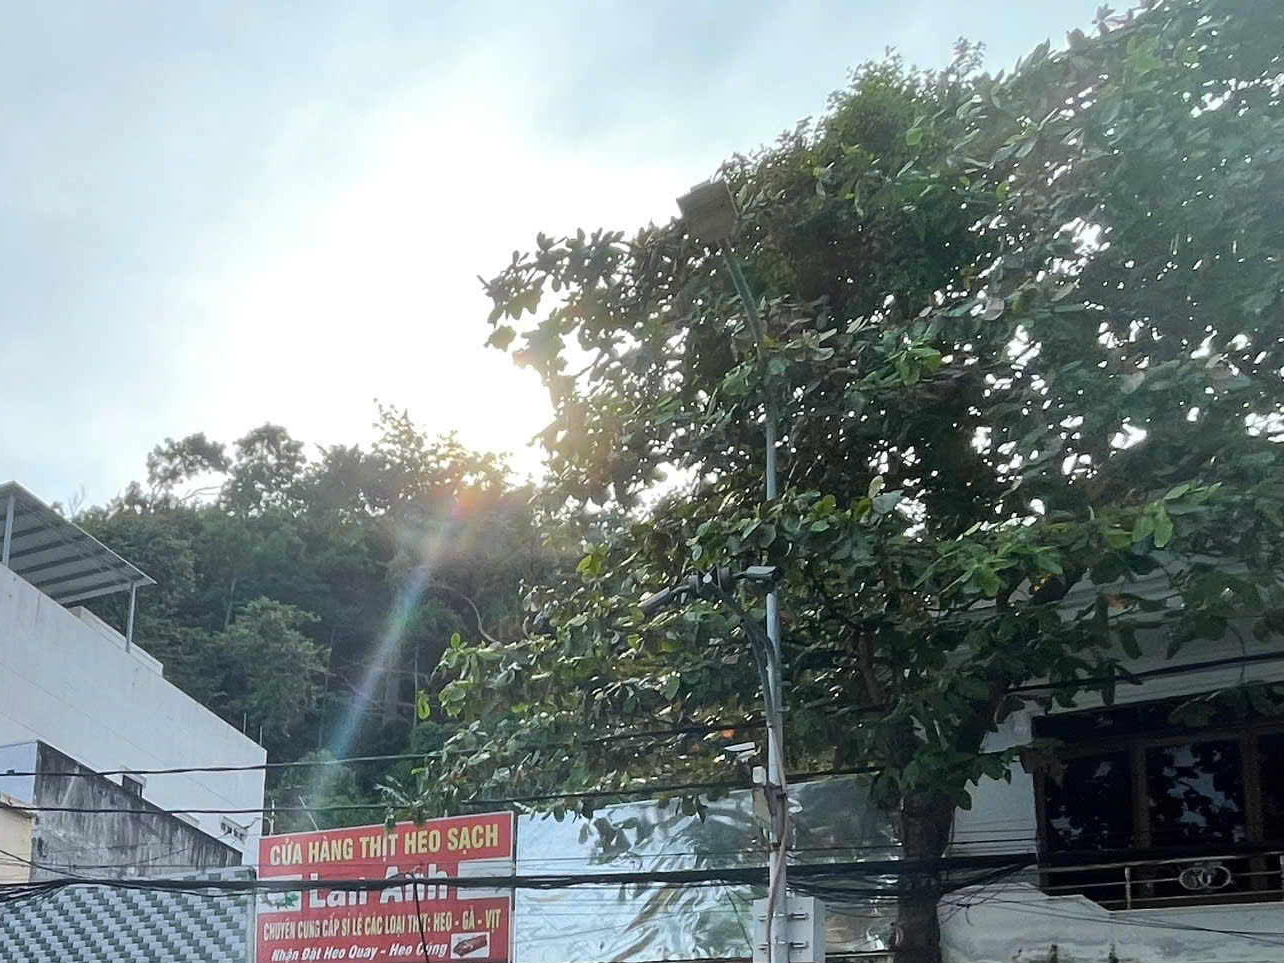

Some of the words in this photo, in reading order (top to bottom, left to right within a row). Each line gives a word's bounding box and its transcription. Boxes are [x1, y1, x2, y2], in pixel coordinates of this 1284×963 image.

[270, 837, 303, 866] CỬA
[308, 836, 354, 864] HÀNG
[359, 832, 399, 862] THỊT
[404, 829, 442, 855] HEO
[447, 823, 499, 855] SẠCH
[309, 872, 368, 908] Lan
[379, 863, 448, 904] Anh
[263, 917, 296, 941] CHUYÊN
[297, 919, 321, 939] CUNG
[364, 911, 383, 936] CÁC
[384, 915, 405, 938] LOẠI
[433, 911, 453, 932] HEO
[462, 905, 476, 930] GÀ
[485, 909, 502, 933] VỊT
[271, 947, 299, 963] Nhận
[323, 946, 346, 960] Heo
[348, 944, 379, 960] Quay
[389, 943, 413, 957] Heo
[416, 941, 448, 958] Cúng
